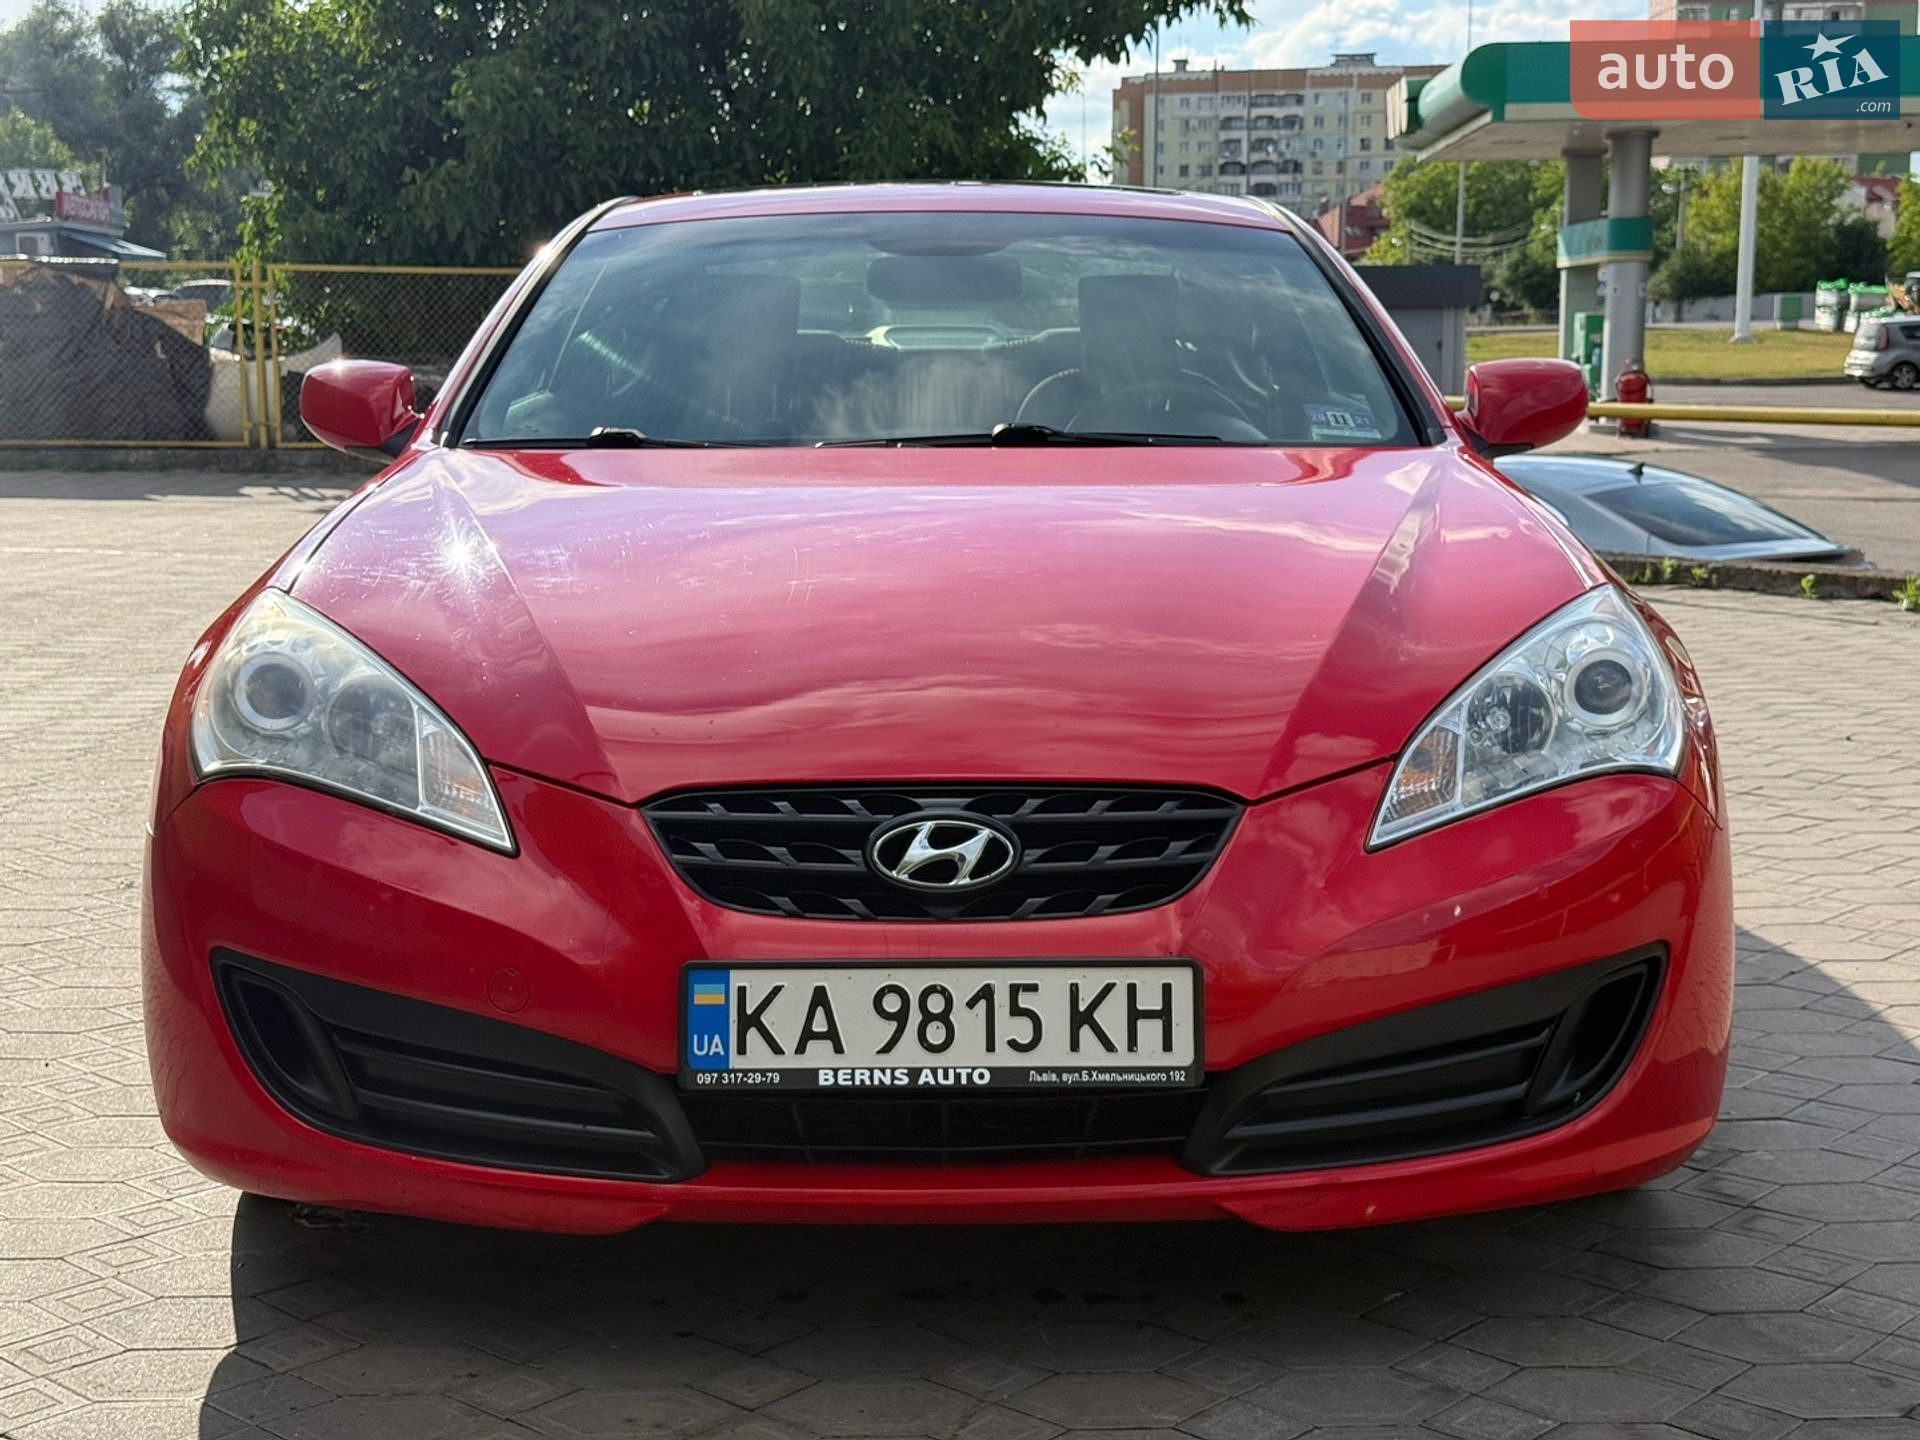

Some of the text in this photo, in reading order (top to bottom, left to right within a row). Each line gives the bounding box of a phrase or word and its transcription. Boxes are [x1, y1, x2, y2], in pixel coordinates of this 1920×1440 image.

[1330, 413, 1349, 425] 11
[736, 982, 1174, 1056] KA 9815 KH
[693, 1034, 725, 1056] UA
[696, 1072, 780, 1085] 097 317-29-79
[818, 1067, 991, 1086] BERNS AUTO
[1028, 1070, 1060, 1084] Львів,
[1169, 1070, 1186, 1082] 192
